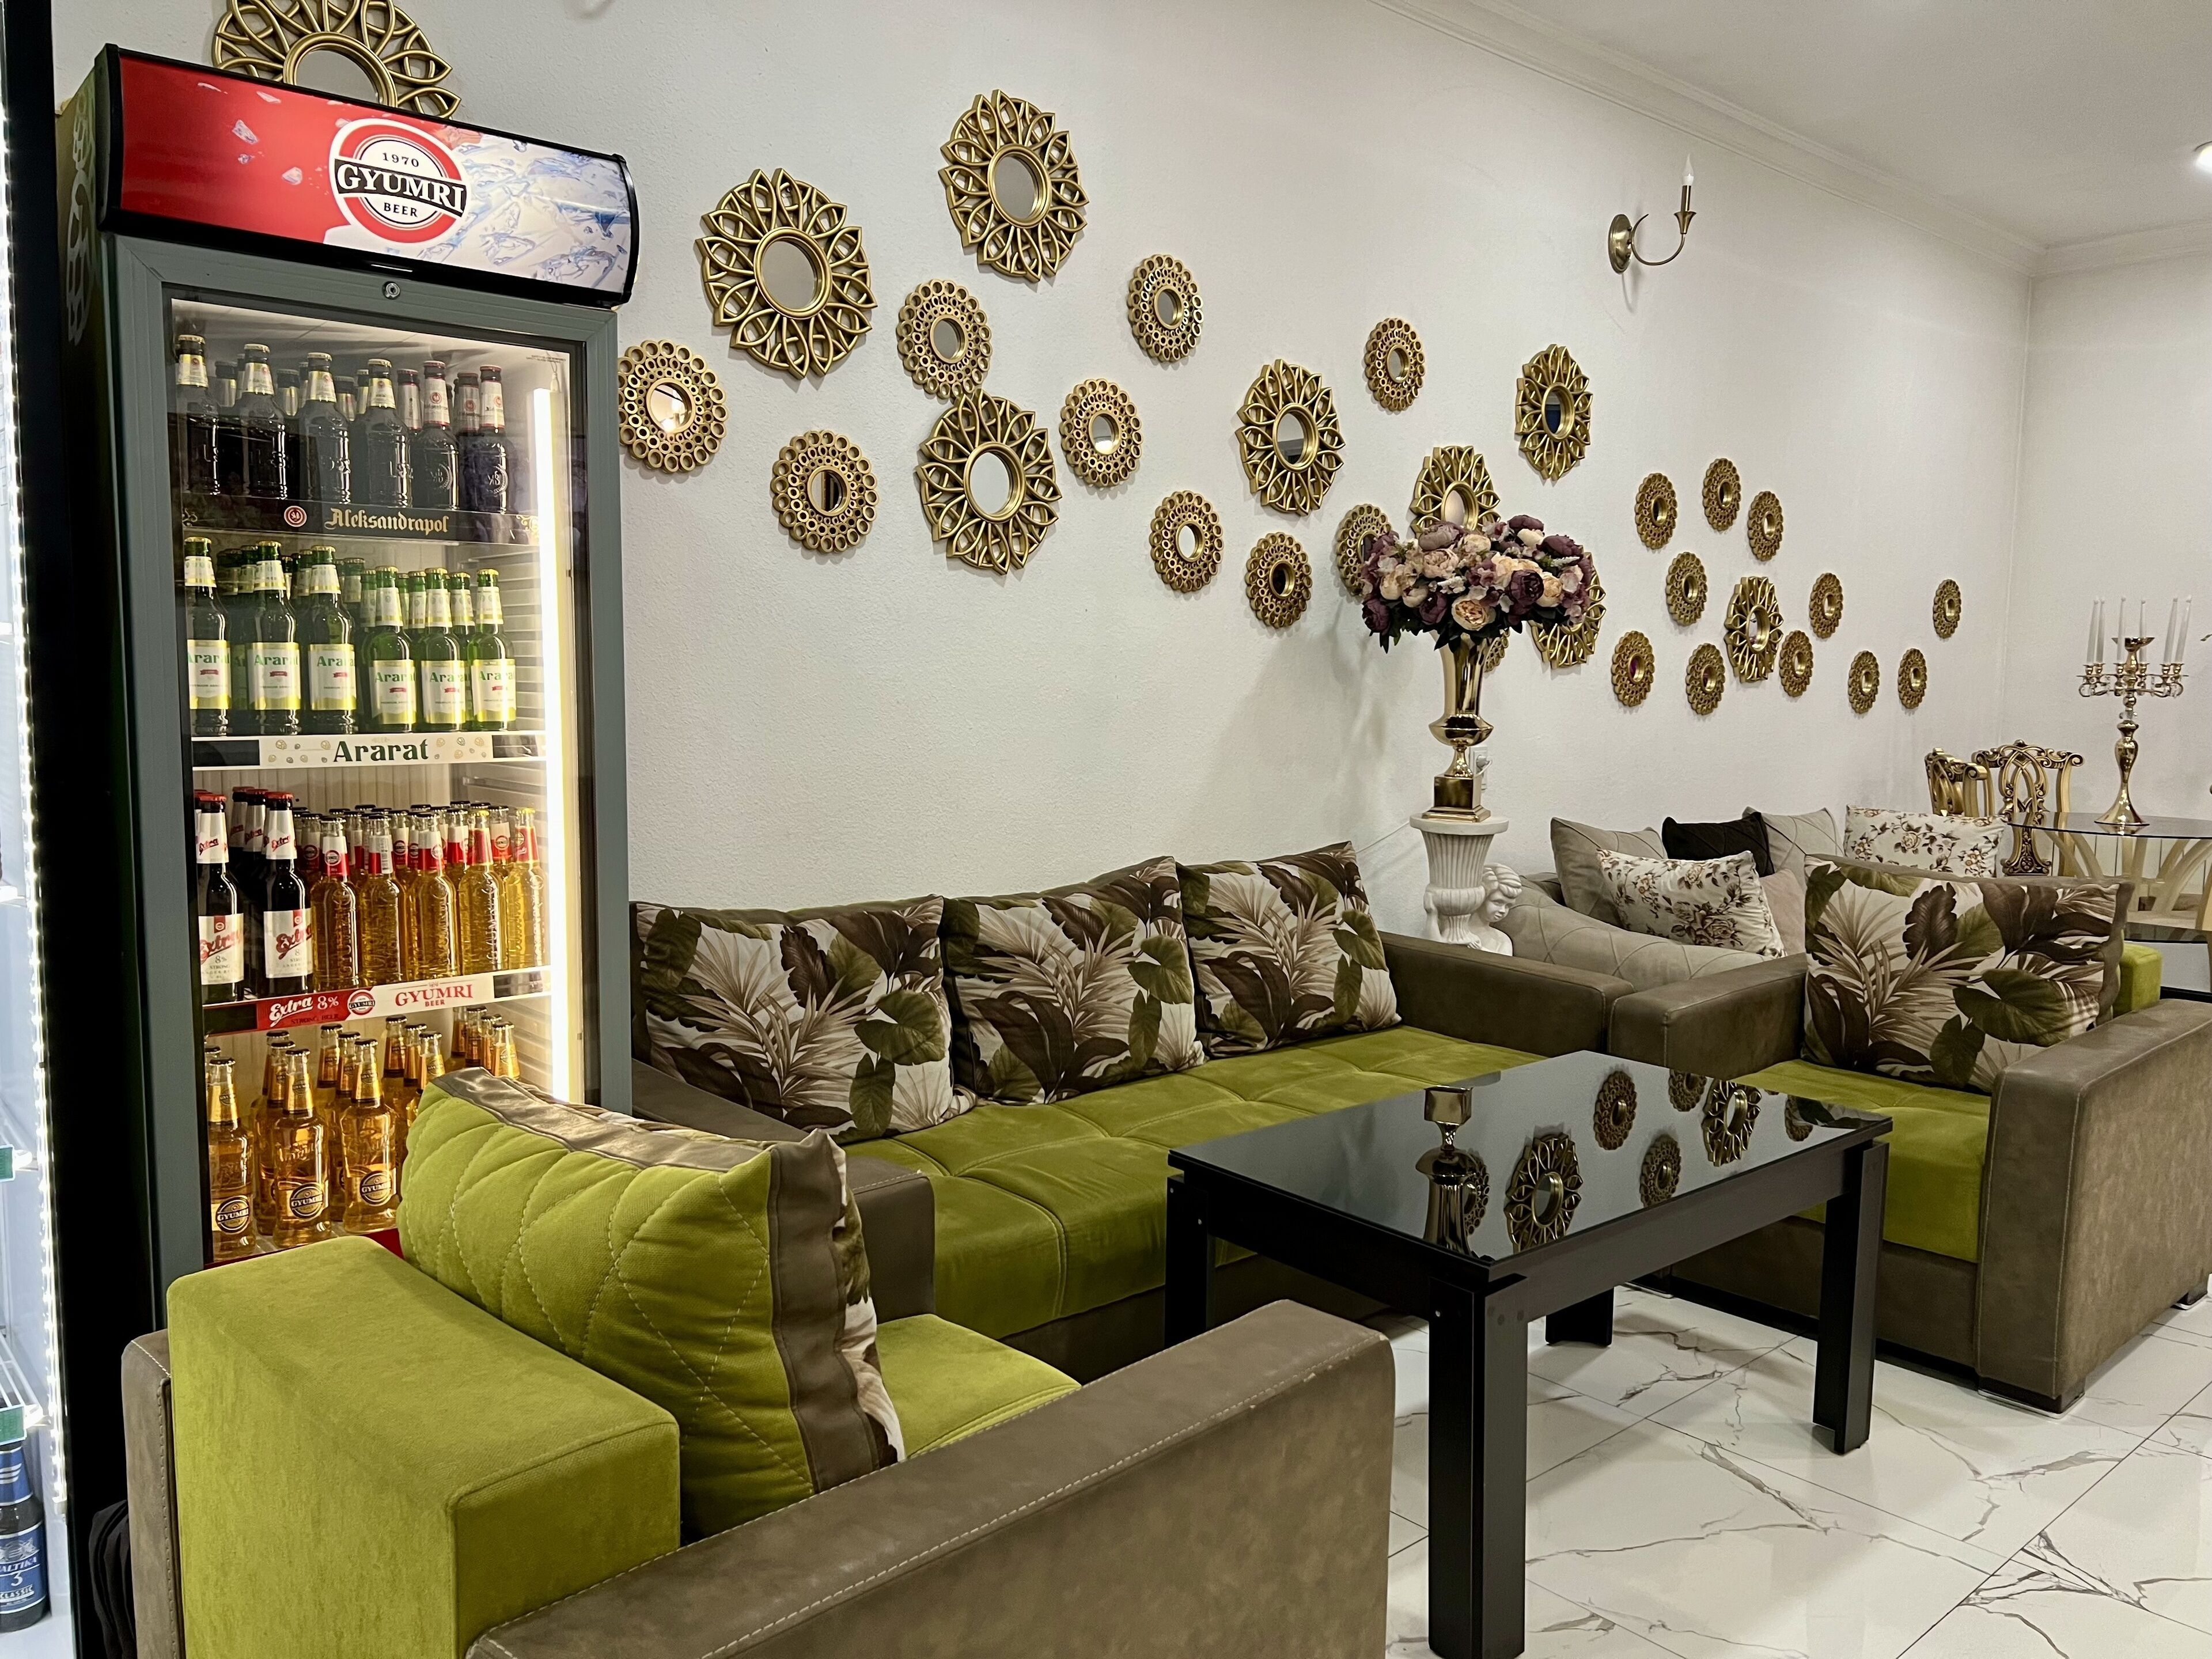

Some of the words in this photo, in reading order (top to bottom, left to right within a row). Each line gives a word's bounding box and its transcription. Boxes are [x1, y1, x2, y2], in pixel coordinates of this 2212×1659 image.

[382, 152, 420, 168] 1970
[337, 163, 464, 213] GYUMRI
[383, 202, 418, 218] BEER
[324, 507, 450, 536] Aleksandrapol
[254, 654, 298, 666] Arart
[333, 738, 429, 763] Ararat
[395, 984, 474, 1007] GYUMRI
[425, 999, 445, 1007] BEER
[269, 997, 314, 1028] Extra
[317, 995, 339, 1010] 8%
[291, 1016, 319, 1025] STRONG
[321, 1013, 339, 1021] BEER
[0, 1556, 37, 1573] ALTIKA
[10, 1571, 24, 1587] 3
[0, 1584, 33, 1600] CLASSIC
